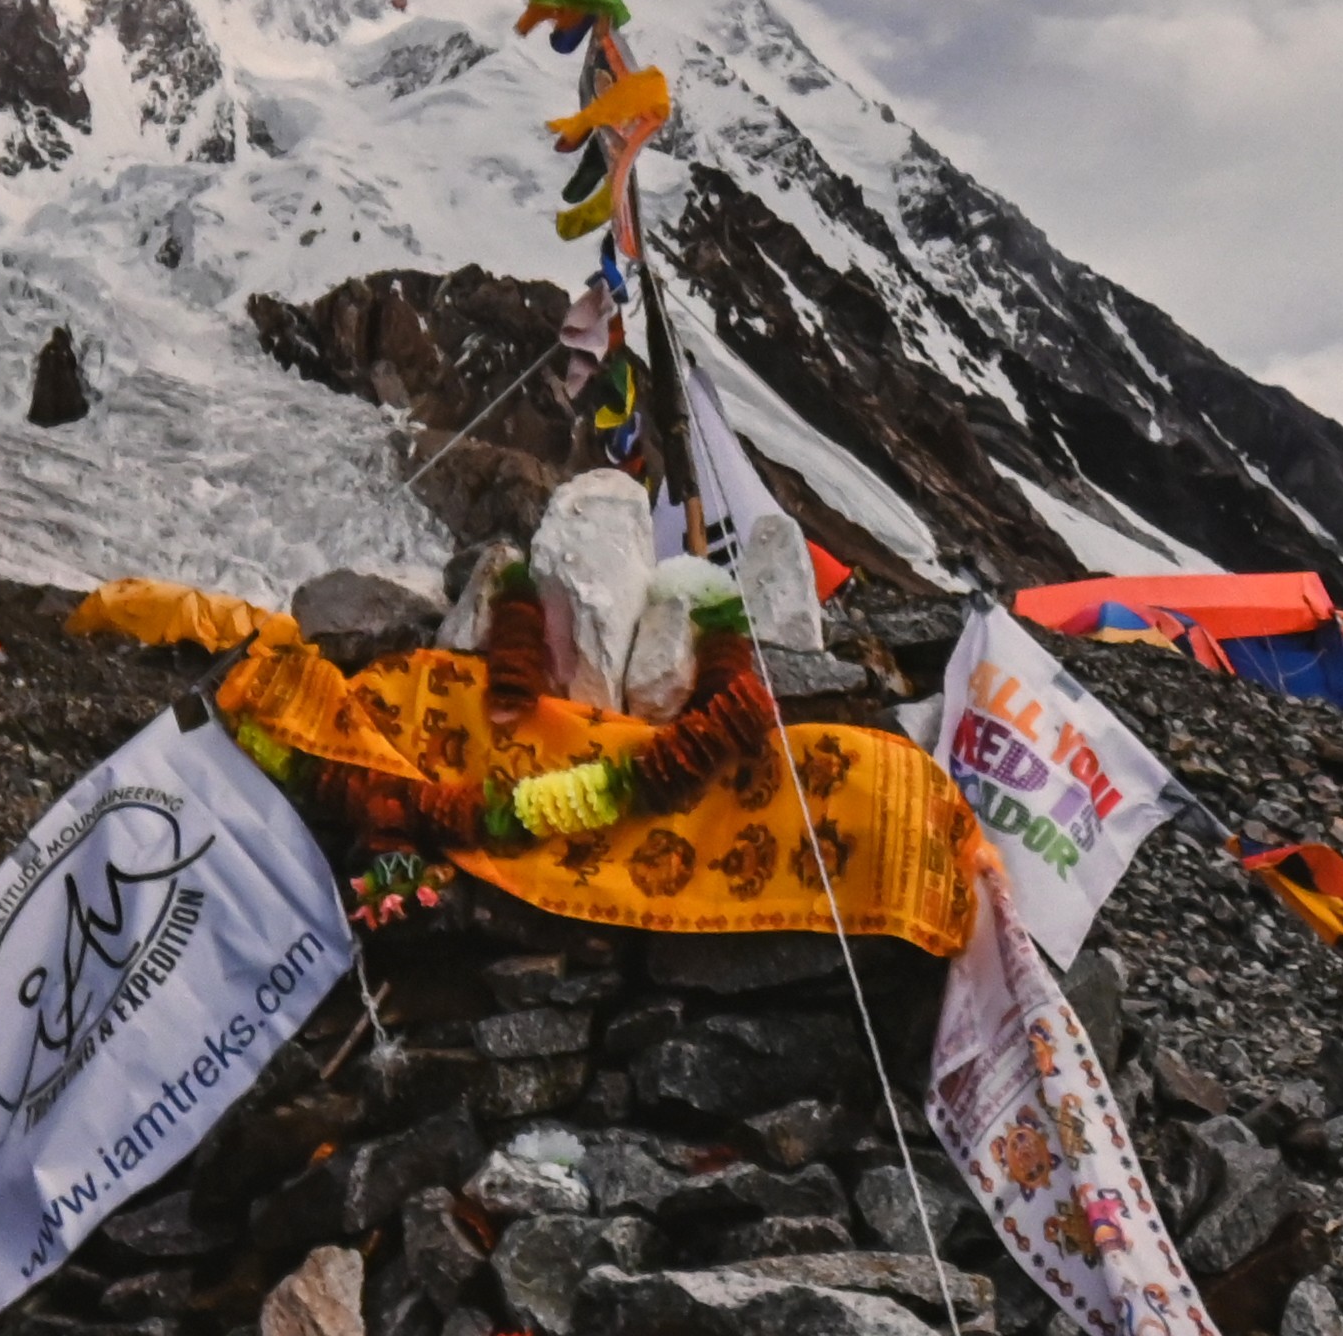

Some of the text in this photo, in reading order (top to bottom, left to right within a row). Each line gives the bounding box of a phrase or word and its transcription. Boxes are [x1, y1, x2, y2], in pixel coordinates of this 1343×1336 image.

[968, 660, 1123, 821] ALL YOU
[949, 753, 1080, 884] ADOR
[1049, 781, 1103, 853] IS
[112, 887, 205, 1023] EXPEDITION
[20, 930, 326, 1279] www.iamtreks.com
